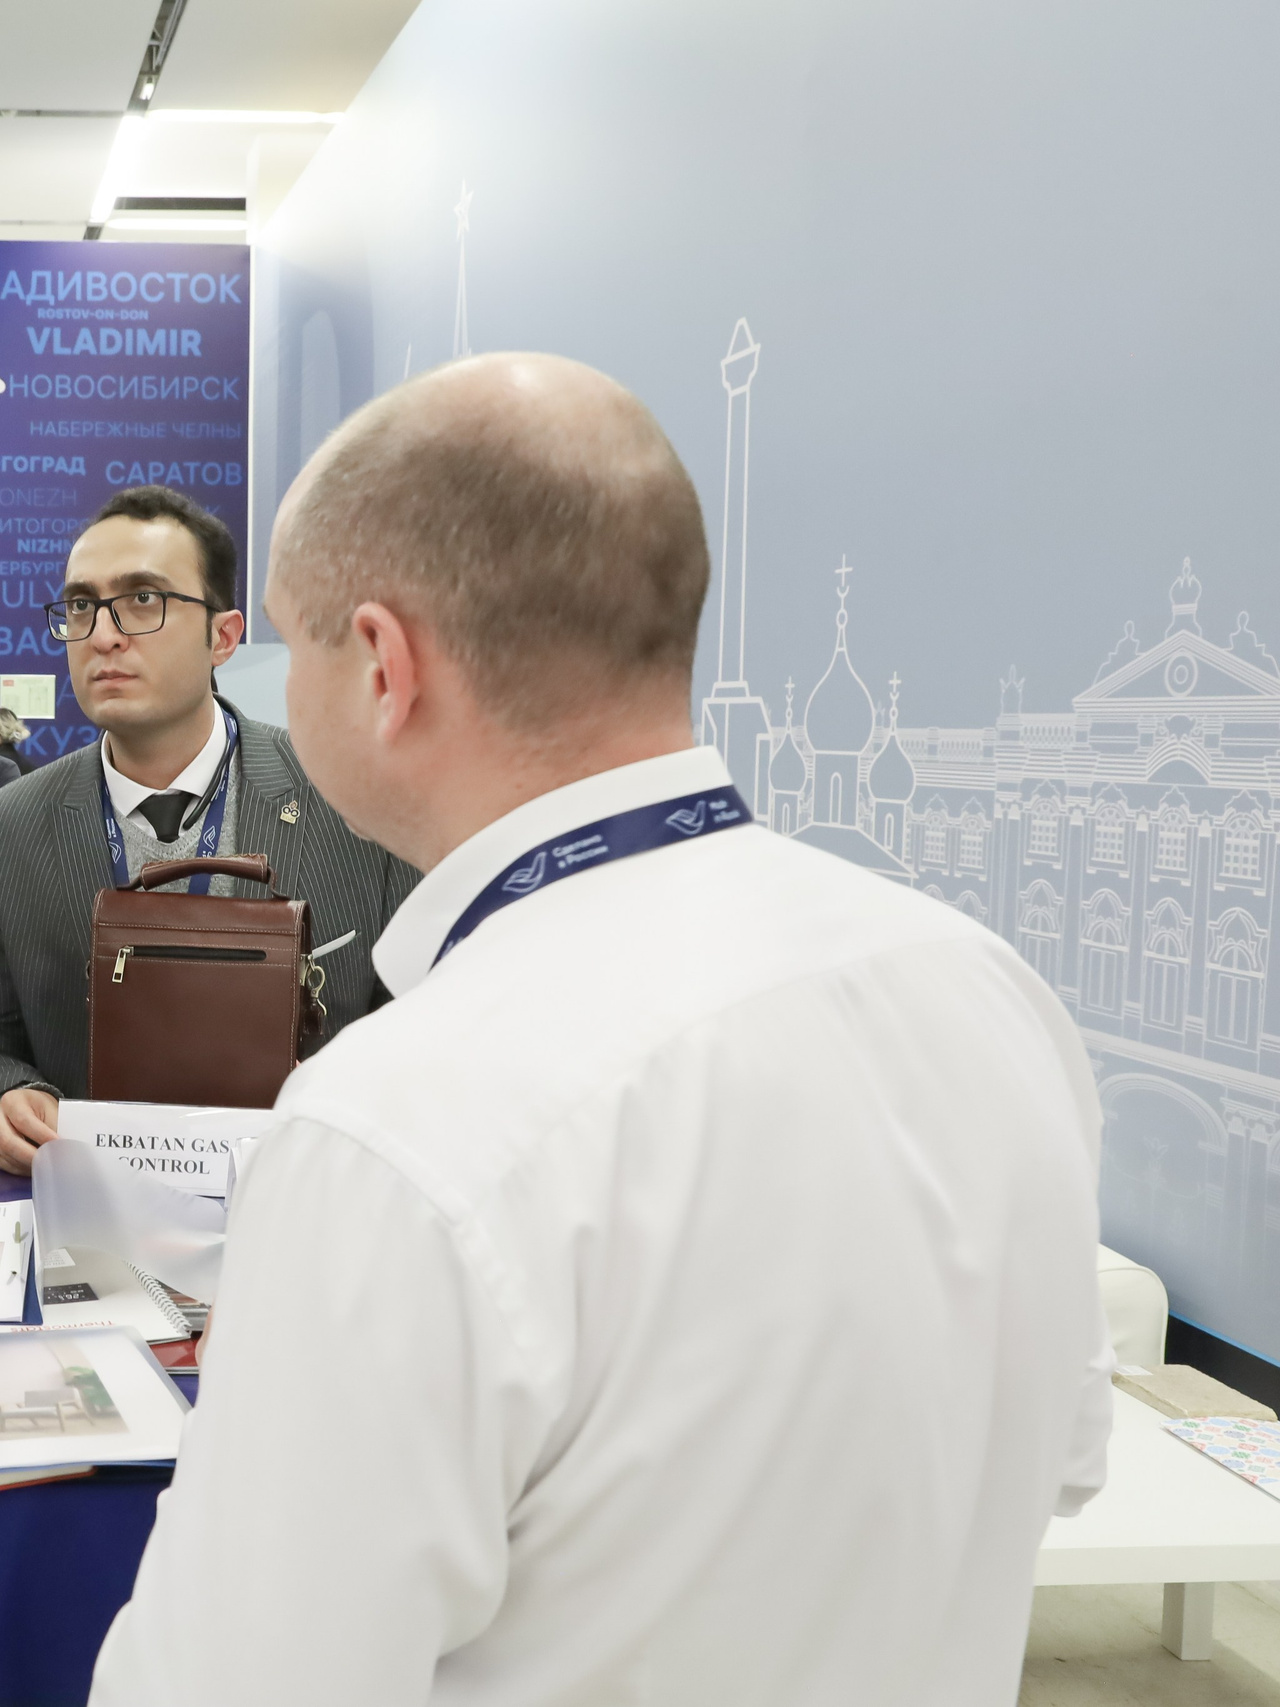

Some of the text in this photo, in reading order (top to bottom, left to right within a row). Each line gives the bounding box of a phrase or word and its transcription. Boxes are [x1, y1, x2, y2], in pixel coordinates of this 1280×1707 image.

[37, 307, 149, 321] ROSTOV-ON-DON
[26, 326, 202, 357] VLADIMIR
[8, 373, 240, 401] НОВОСИБИРСК
[30, 420, 242, 439] НАБЕРЕЖНЫЕ ЧЕЛНЫ
[105, 460, 243, 486] САРАТОВ
[1, 580, 66, 609] ULY
[95, 1133, 229, 1154] EKBATAN GAS
